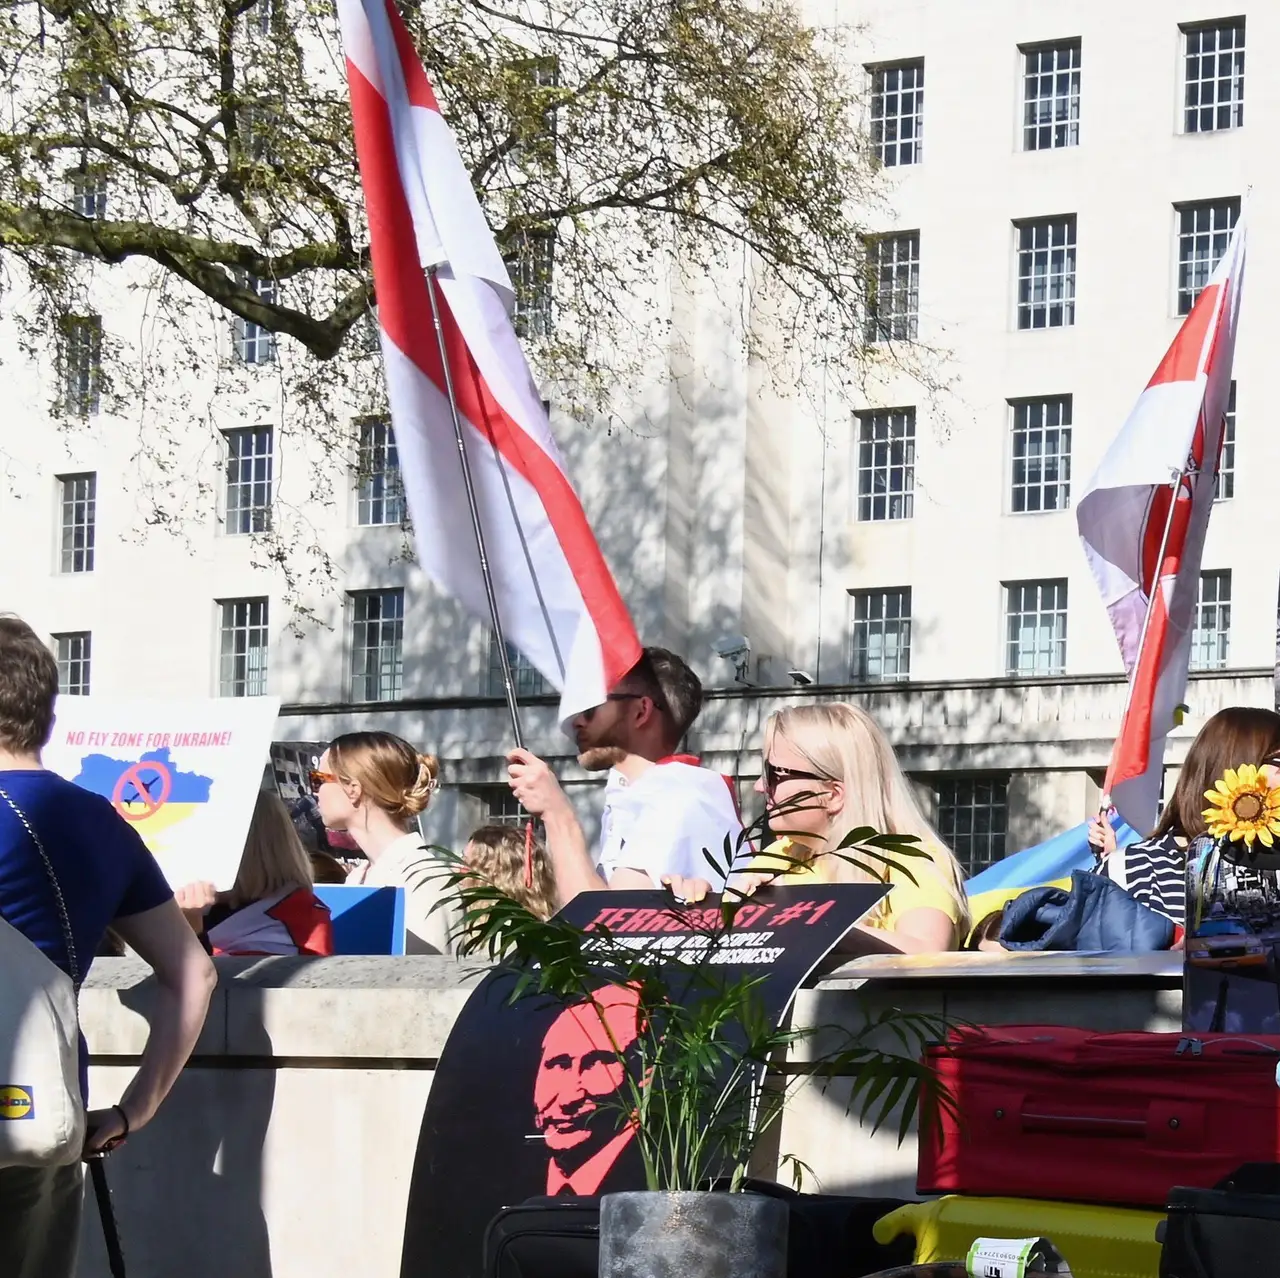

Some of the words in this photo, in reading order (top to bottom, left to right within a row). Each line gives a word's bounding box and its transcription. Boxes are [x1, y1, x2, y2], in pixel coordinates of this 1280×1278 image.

[66, 731, 85, 745] NO
[88, 732, 109, 746] FLY
[111, 732, 144, 747] ZONE
[146, 733, 171, 747] FOR
[173, 731, 232, 747] UKRAINE!
[768, 900, 836, 926] #1
